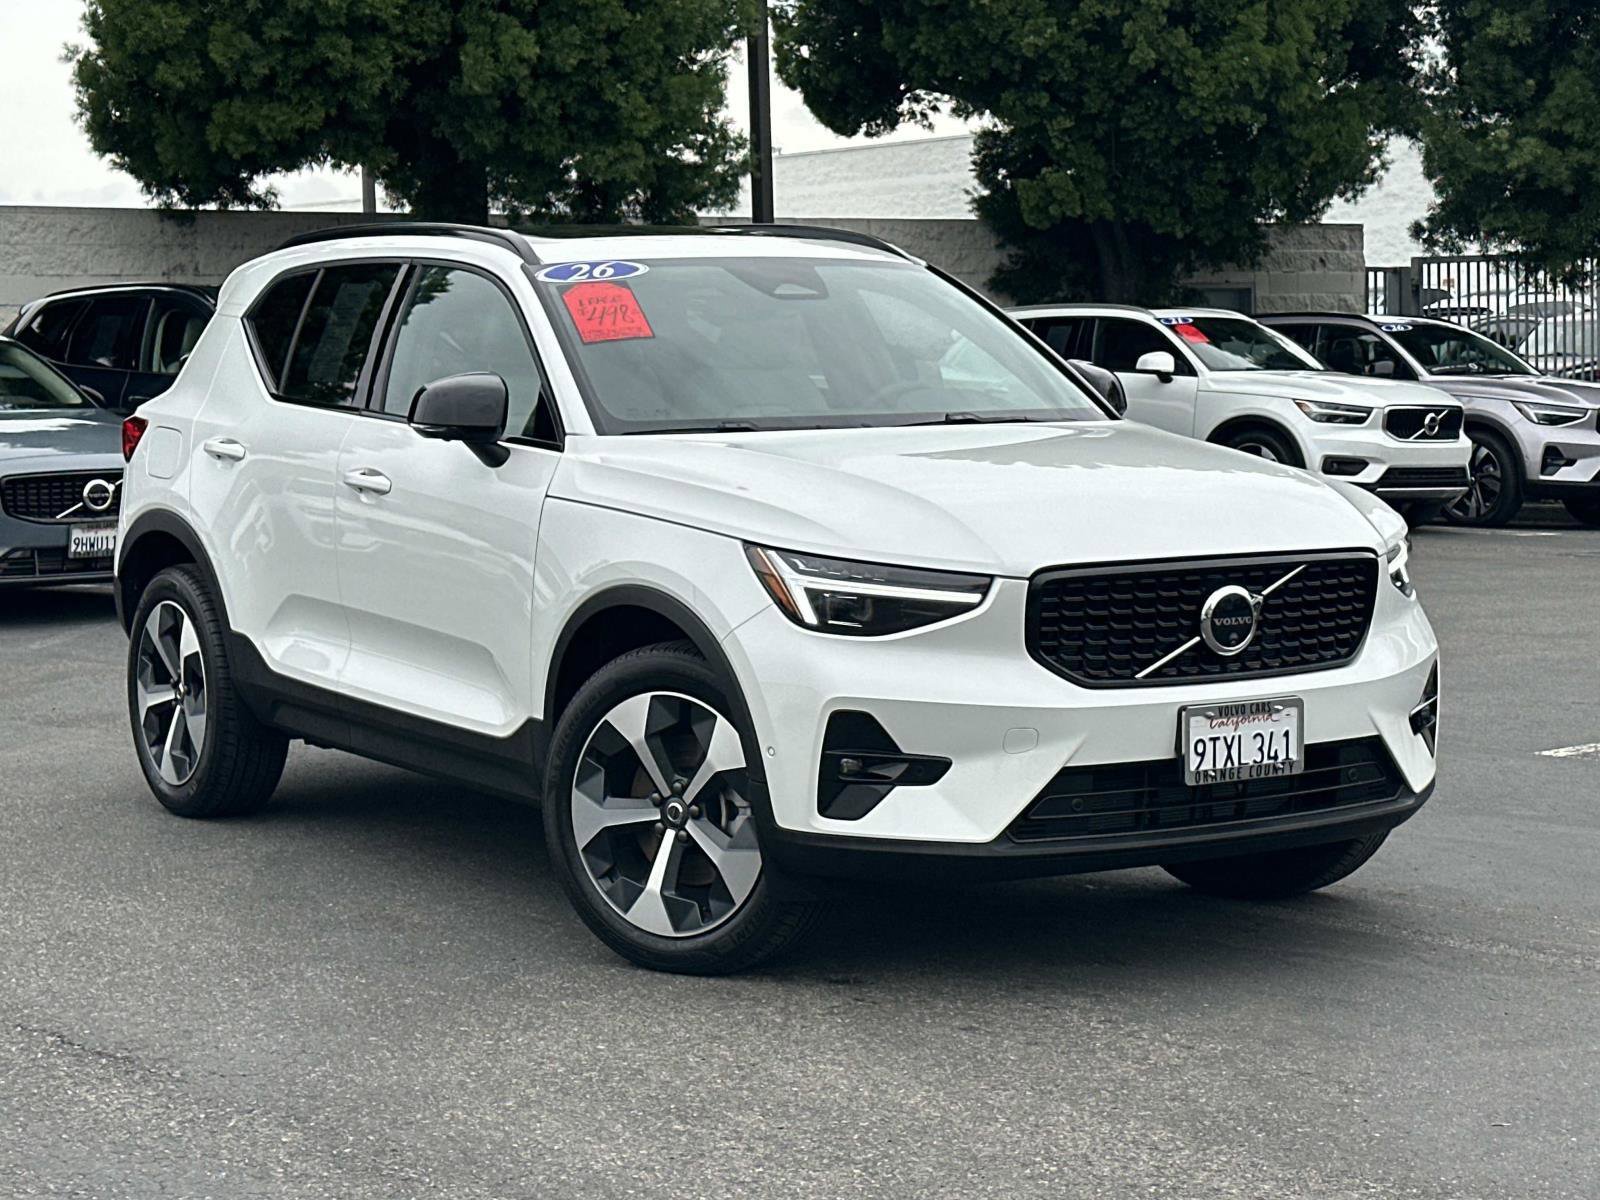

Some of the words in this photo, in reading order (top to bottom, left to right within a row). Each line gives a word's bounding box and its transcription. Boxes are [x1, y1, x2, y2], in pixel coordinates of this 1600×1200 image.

[566, 261, 616, 280] 26
[1212, 616, 1253, 626] VOLVO
[1218, 704, 1246, 717] VOLVO
[1250, 702, 1272, 714] CARS
[1209, 713, 1279, 732] California
